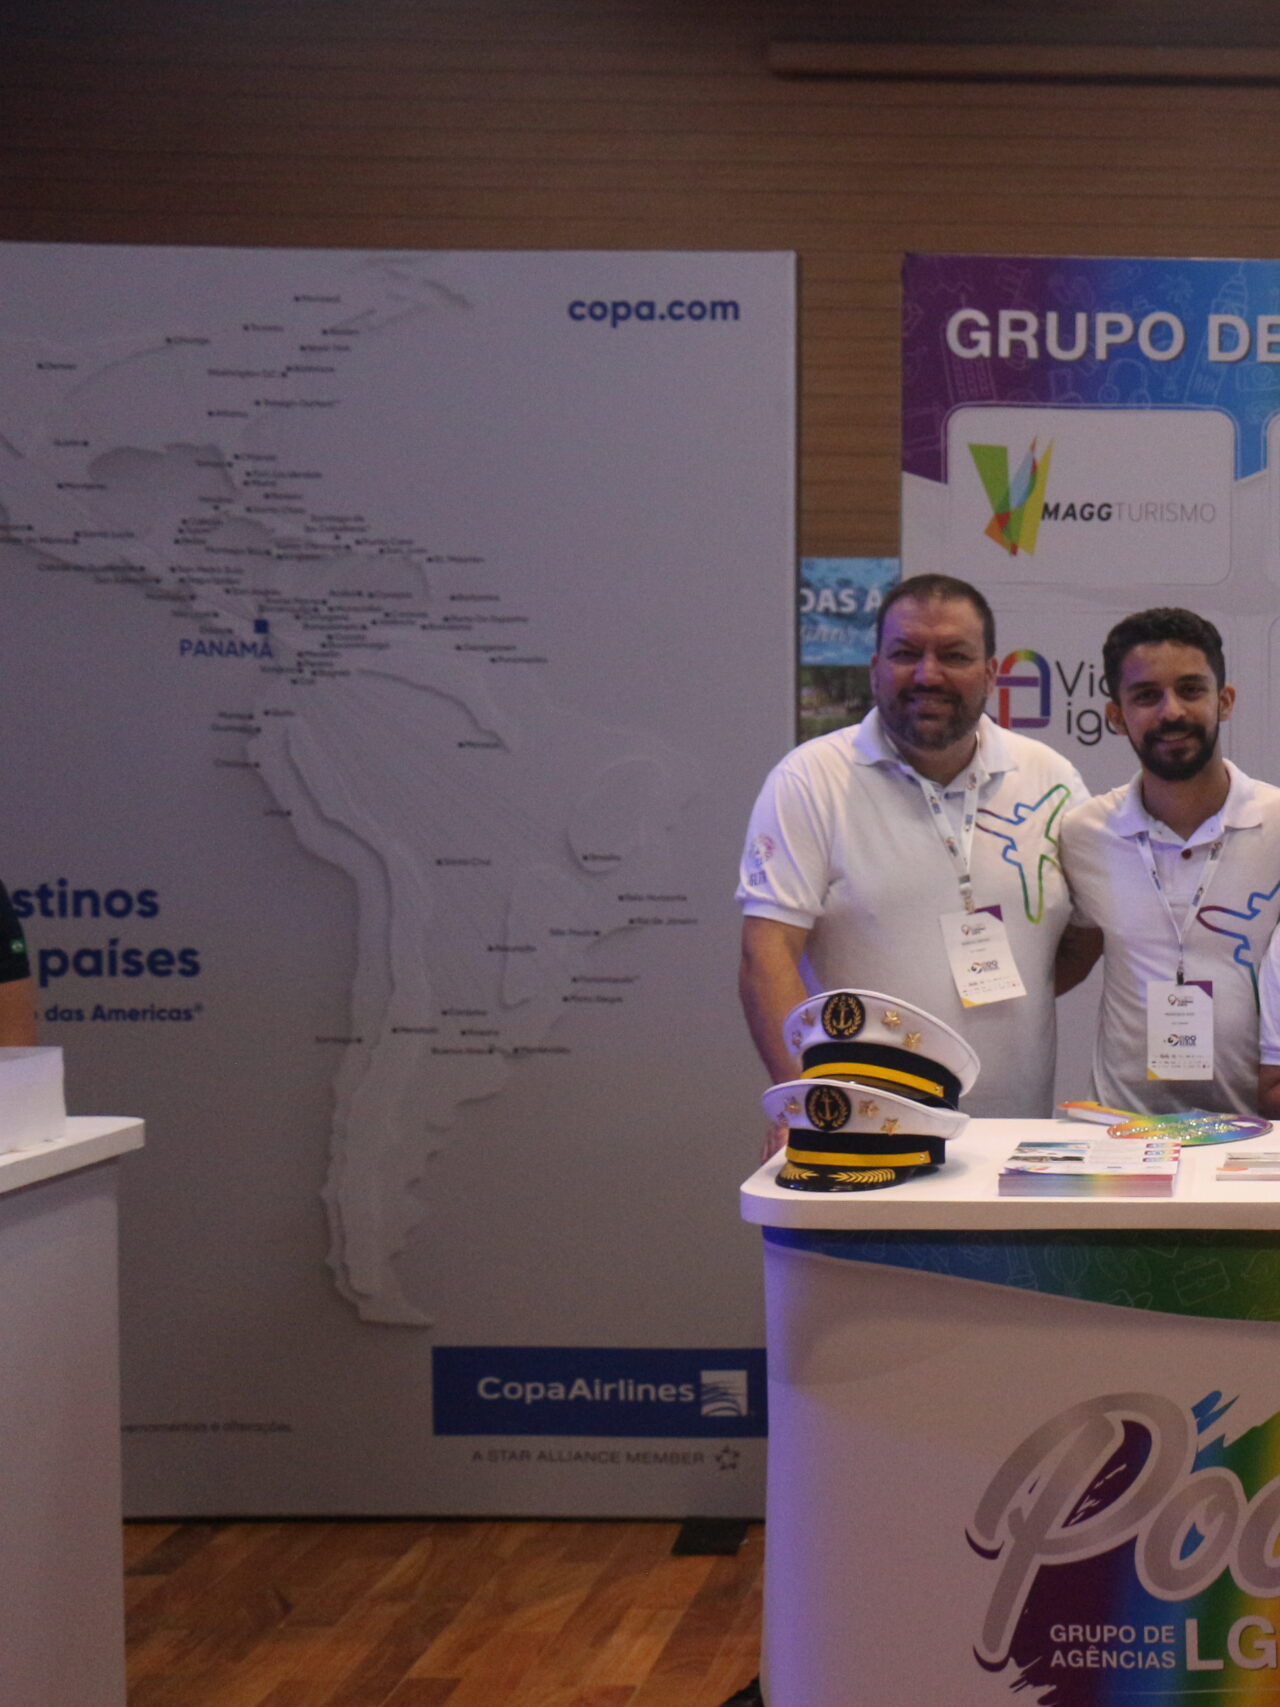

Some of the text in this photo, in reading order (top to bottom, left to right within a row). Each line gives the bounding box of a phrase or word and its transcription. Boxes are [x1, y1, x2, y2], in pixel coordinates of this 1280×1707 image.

[568, 299, 740, 328] copa.com
[945, 307, 1187, 363] GRUPO
[38, 938, 202, 988] países
[44, 1004, 85, 1022] das
[471, 1449, 705, 1466] A STAR ALLIANCE MEMBER
[1050, 1624, 1137, 1644] GRUPO
[1143, 1626, 1175, 1644] DE
[1050, 1646, 1176, 1670] AGÊNCIAS
